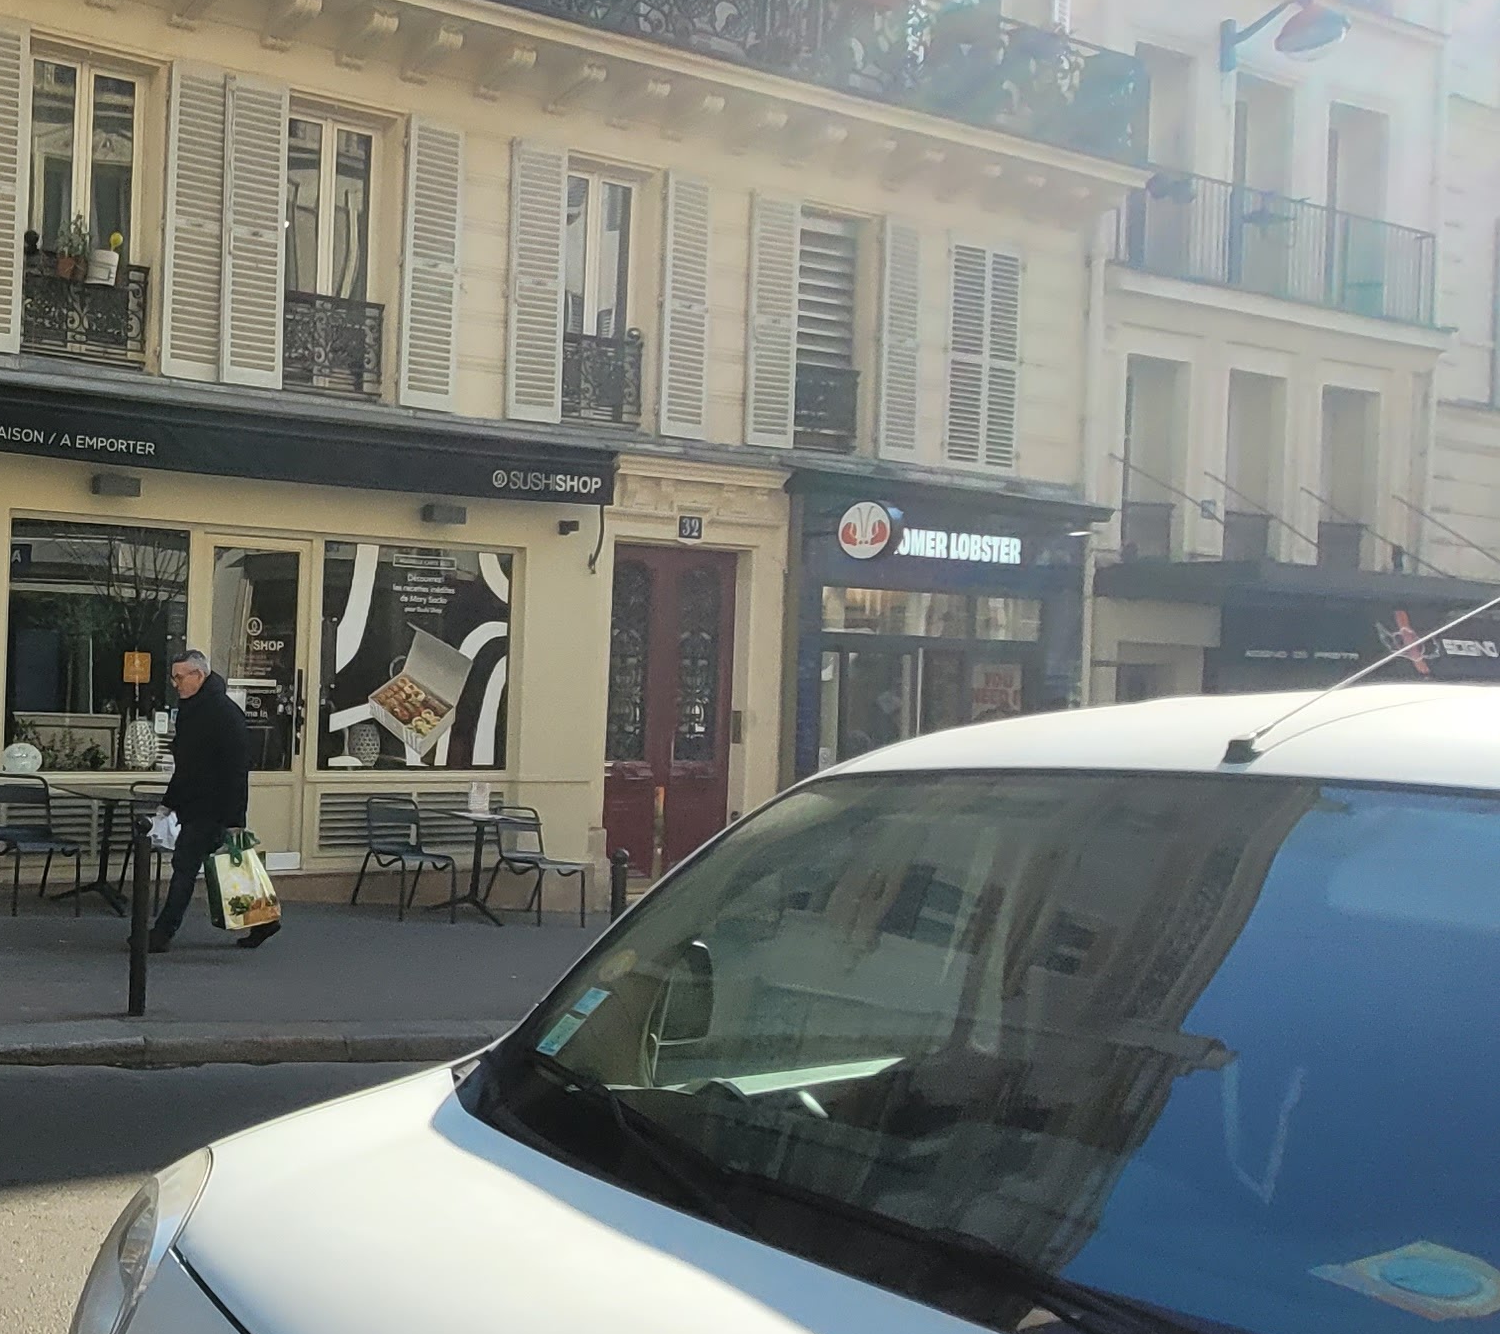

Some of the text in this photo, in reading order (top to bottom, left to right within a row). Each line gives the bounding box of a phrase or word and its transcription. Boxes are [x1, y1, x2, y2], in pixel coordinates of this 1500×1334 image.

[75, 434, 156, 455] EMPORTER
[682, 517, 699, 537] 32
[894, 527, 1021, 565] OMER LOBSTER
